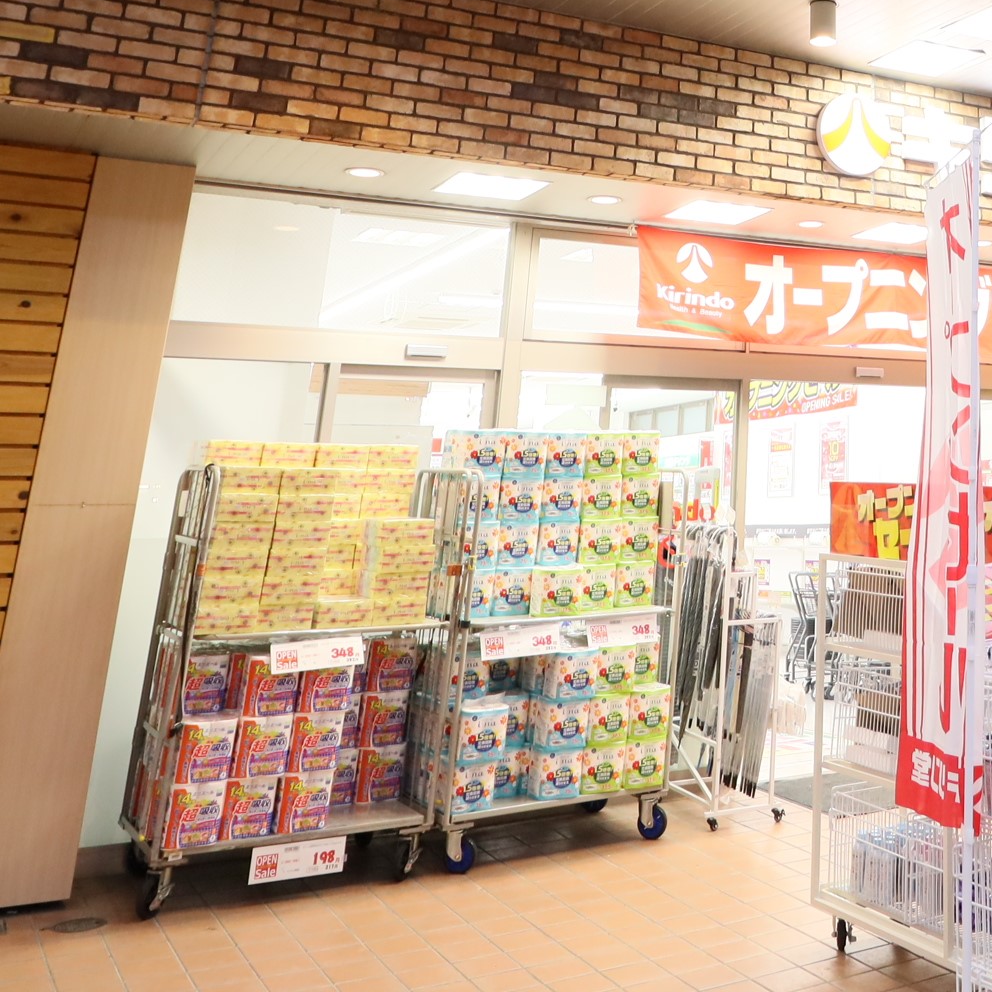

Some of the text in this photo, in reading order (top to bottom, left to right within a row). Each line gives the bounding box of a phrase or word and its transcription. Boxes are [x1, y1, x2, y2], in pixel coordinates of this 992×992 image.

[656, 283, 735, 310] Kirindo
[276, 650, 298, 659] OPEN
[276, 660, 298, 670] Sale
[256, 854, 279, 866] OPEN
[254, 868, 277, 879] Sale
